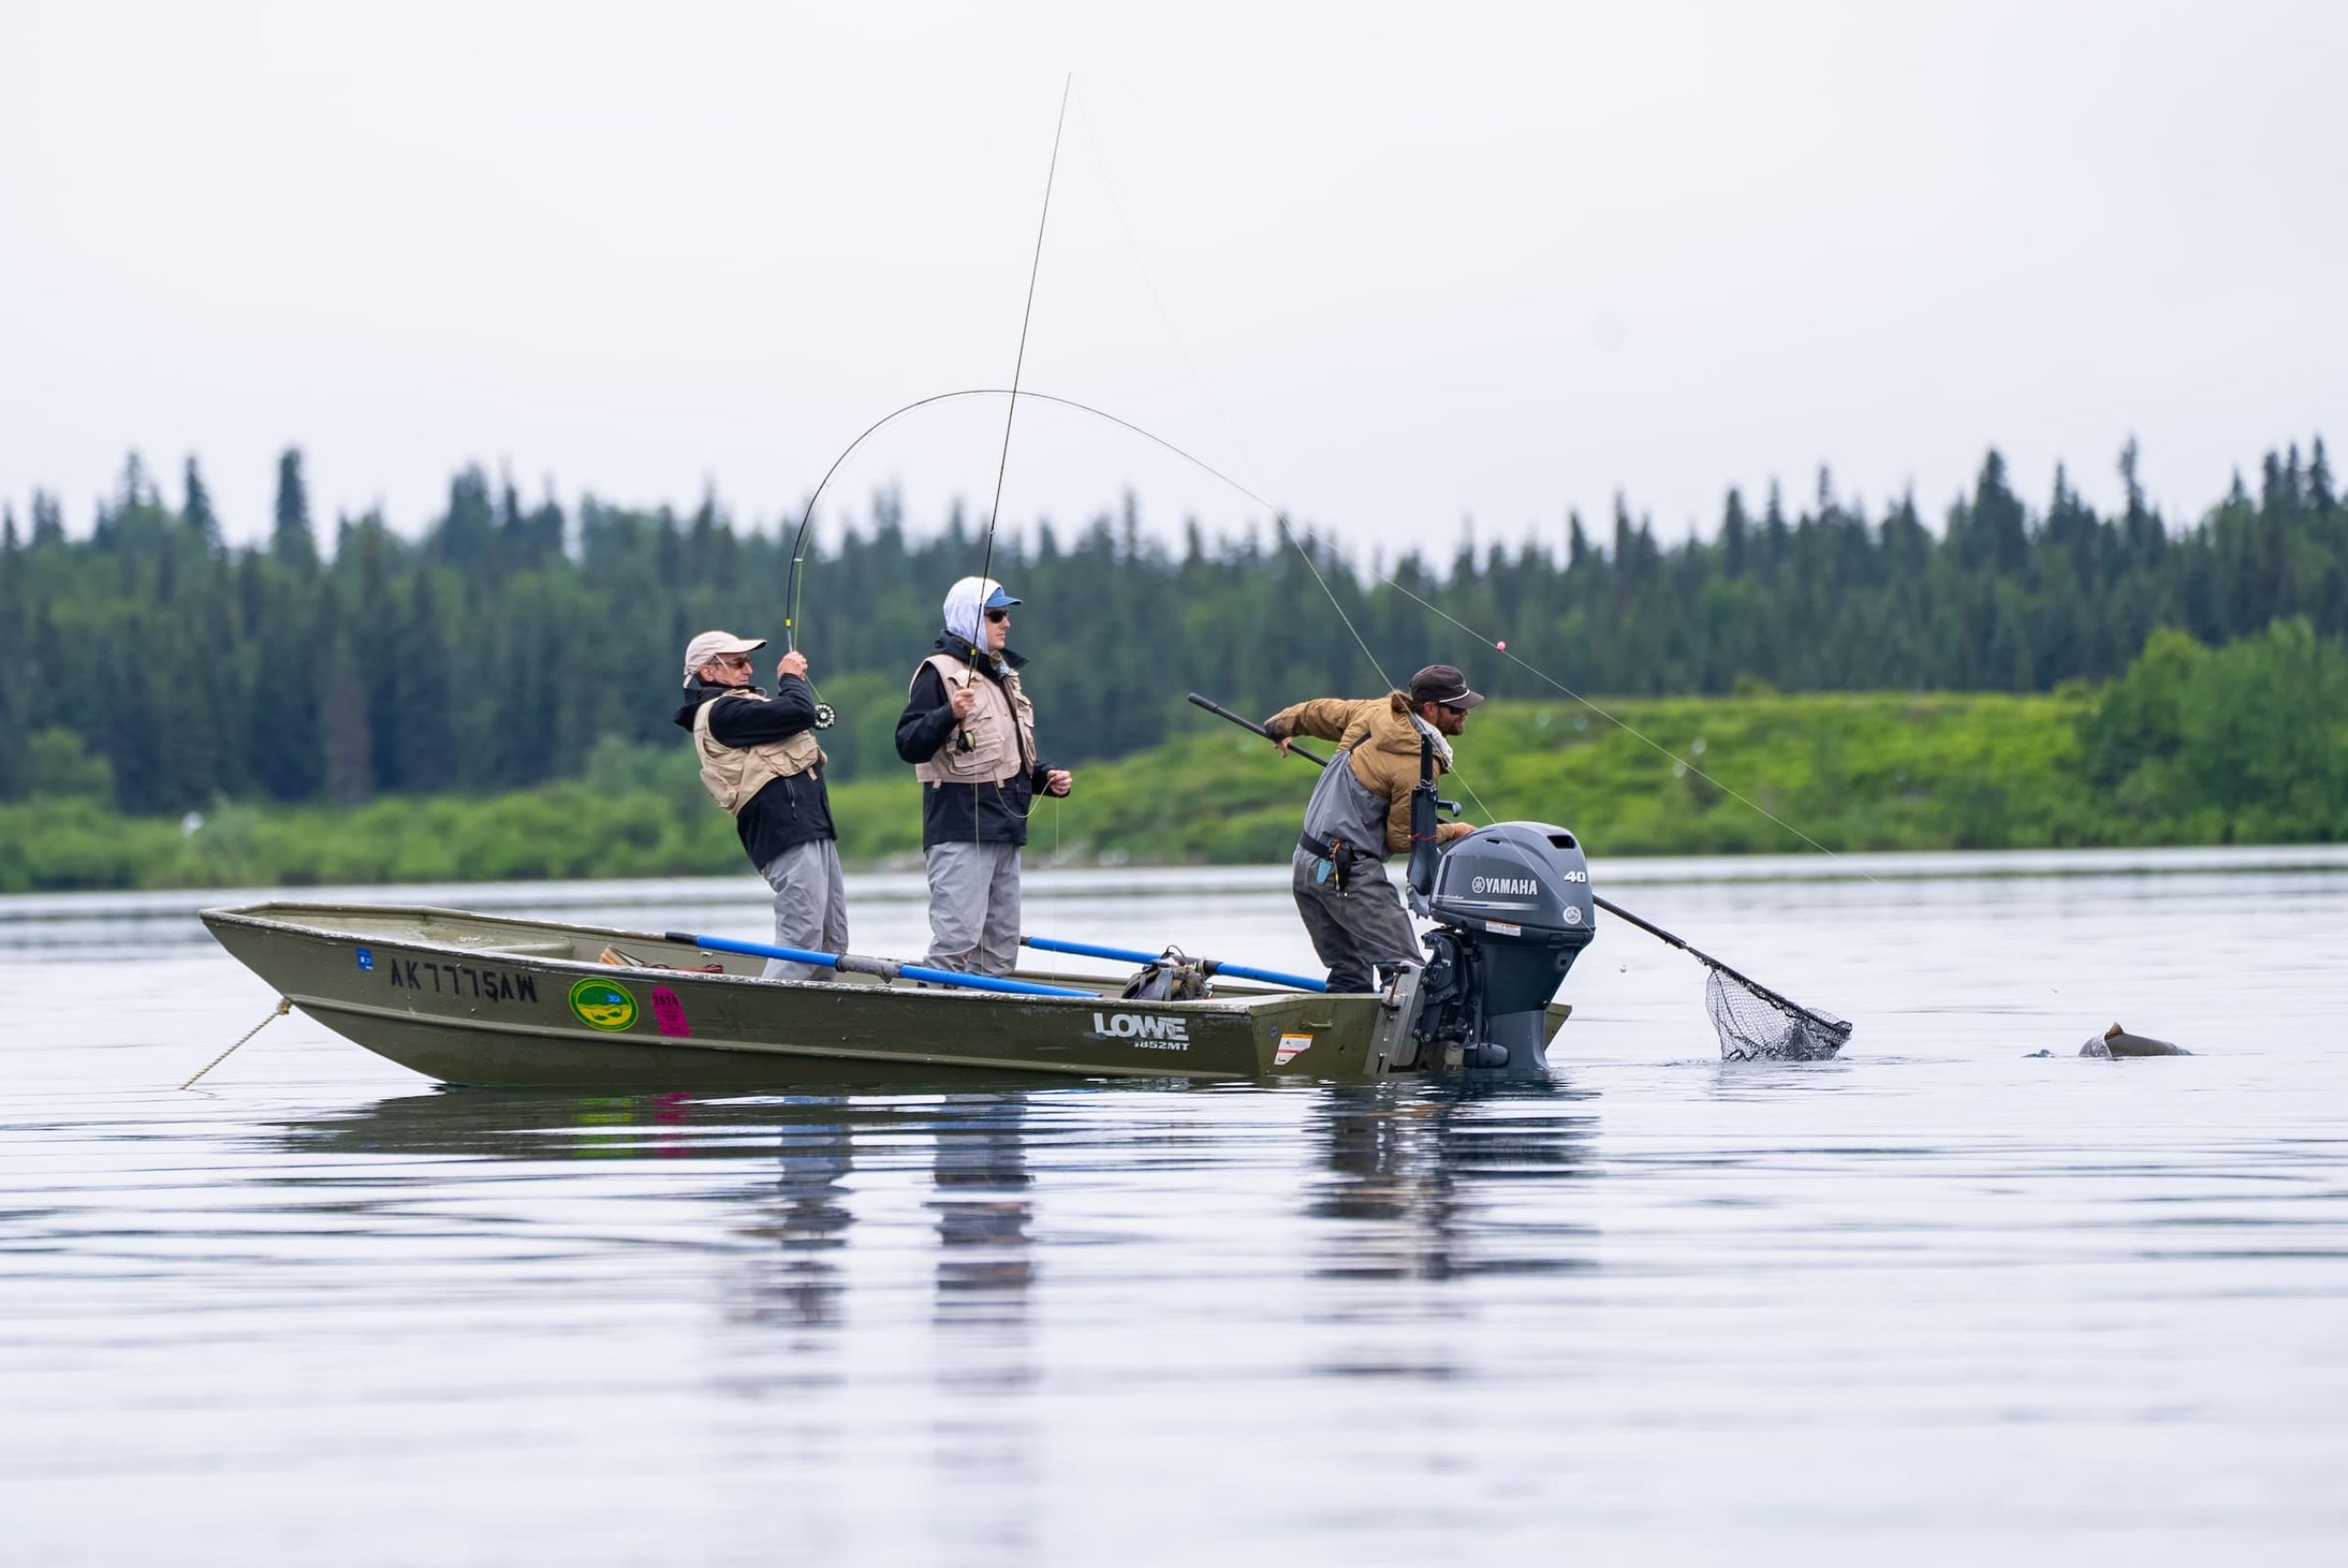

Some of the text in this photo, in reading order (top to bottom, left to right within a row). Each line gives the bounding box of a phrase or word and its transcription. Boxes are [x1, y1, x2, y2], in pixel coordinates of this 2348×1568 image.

[1564, 871, 1587, 883] 40
[1486, 878, 1538, 896] YAMAHA
[1093, 1012, 1190, 1042] LOWE
